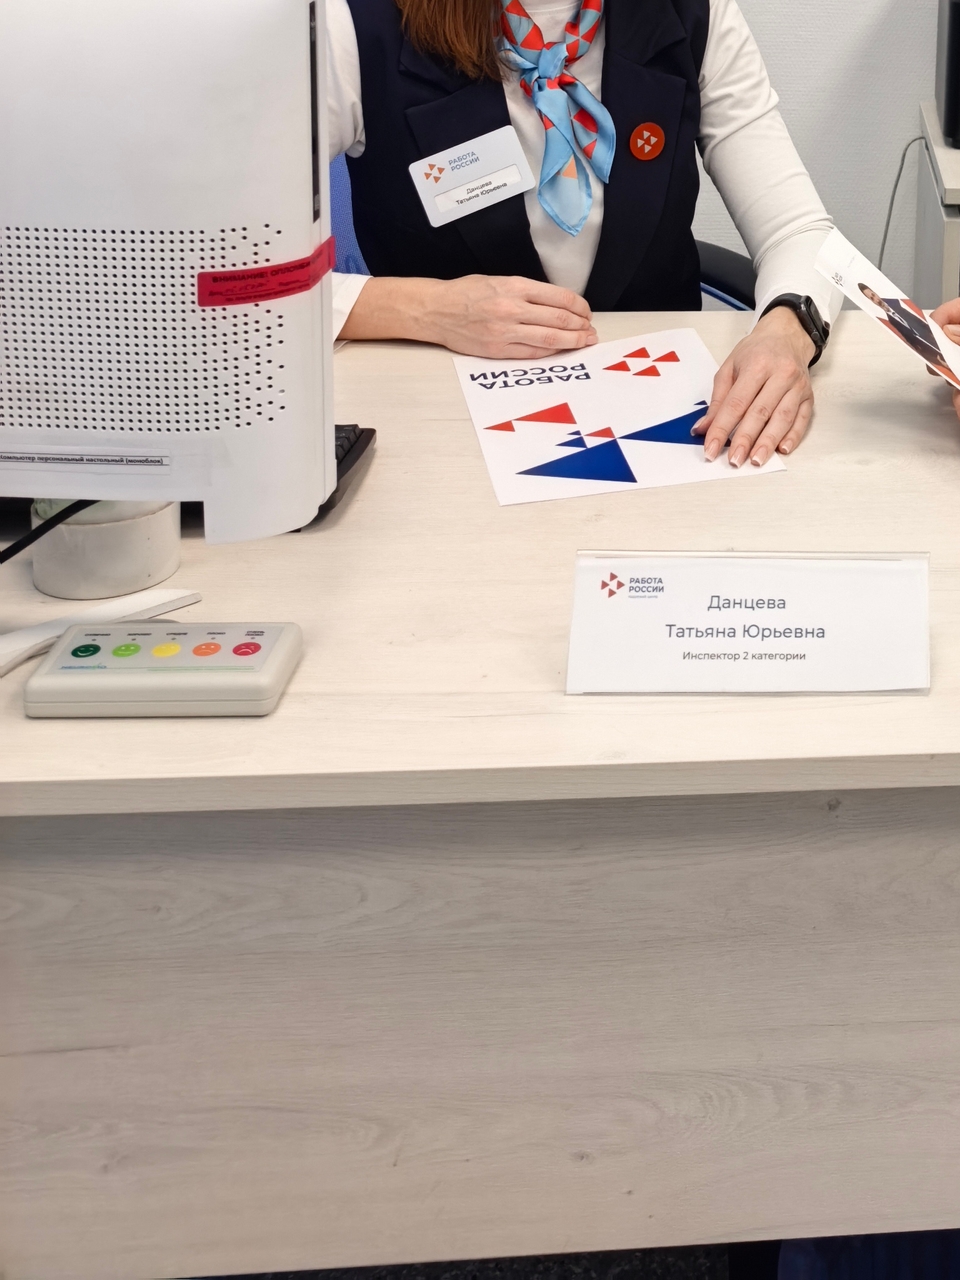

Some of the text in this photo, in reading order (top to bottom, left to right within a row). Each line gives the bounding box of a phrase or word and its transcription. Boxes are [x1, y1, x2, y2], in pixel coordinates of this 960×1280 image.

[448, 151, 476, 166] РАБОТА
[451, 156, 480, 172] РОССИИ
[469, 363, 587, 382] РОССИИ
[478, 372, 591, 390] РАБОТА
[628, 585, 665, 593] РОССИИ
[629, 577, 663, 585] РАБОТА
[707, 595, 786, 611] Данцева
[665, 624, 826, 641] Татьяна Юрьевна
[682, 651, 807, 662] Инспектор 2 категории
